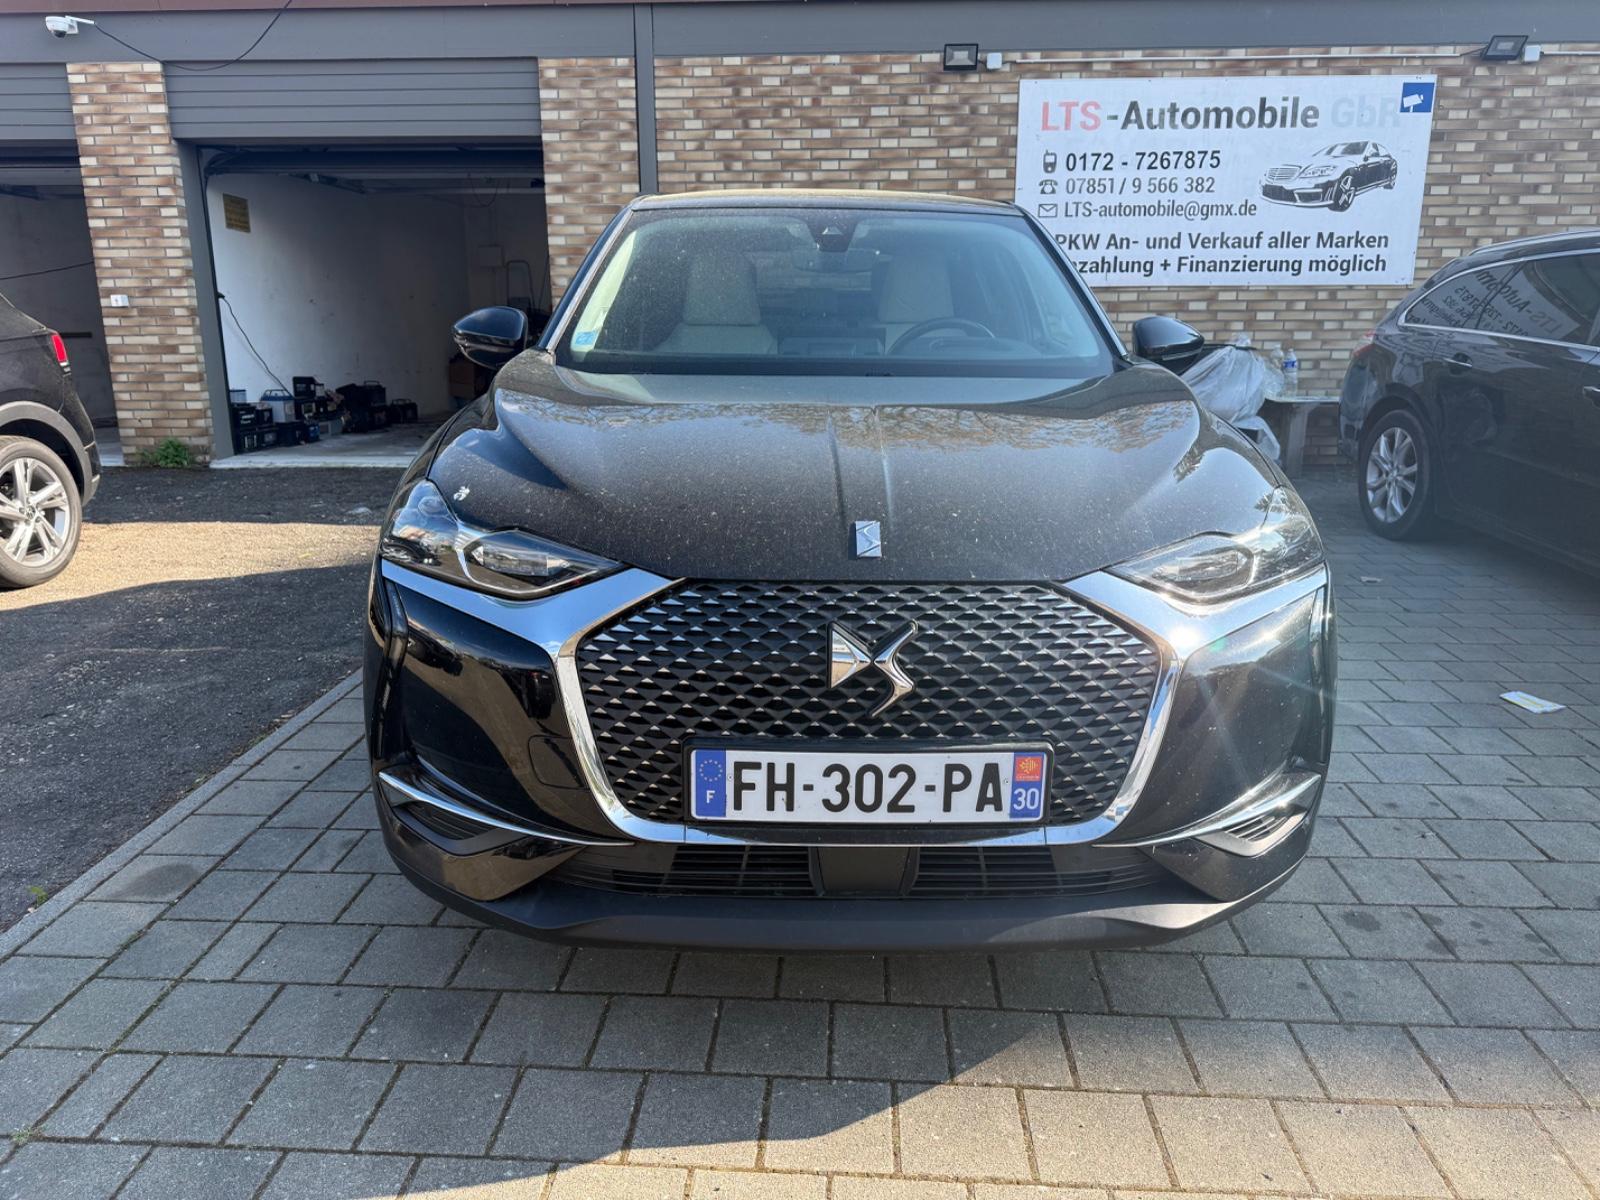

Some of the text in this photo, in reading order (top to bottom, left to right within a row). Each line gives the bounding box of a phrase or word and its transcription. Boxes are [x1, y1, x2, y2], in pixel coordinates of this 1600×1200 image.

[1065, 152, 1114, 171] 0172
[1135, 150, 1221, 171] 7267875
[1132, 177, 1142, 194] 9
[1147, 176, 1178, 194] 566
[1184, 176, 1216, 194] 382
[1064, 199, 1257, 221] LTS-automobile@gmx.de
[1106, 233, 1139, 250] An-
[1146, 231, 1182, 250] und
[1188, 231, 1264, 250] Verkauf
[1267, 231, 1311, 249] aller
[1316, 230, 1389, 249] Marken
[1160, 258, 1171, 271] +
[1177, 254, 1303, 276] Finanzierung
[1308, 254, 1387, 276] möglich
[706, 790, 716, 804] F
[733, 761, 1004, 813] FH-302-PA
[1013, 788, 1040, 810] 30
